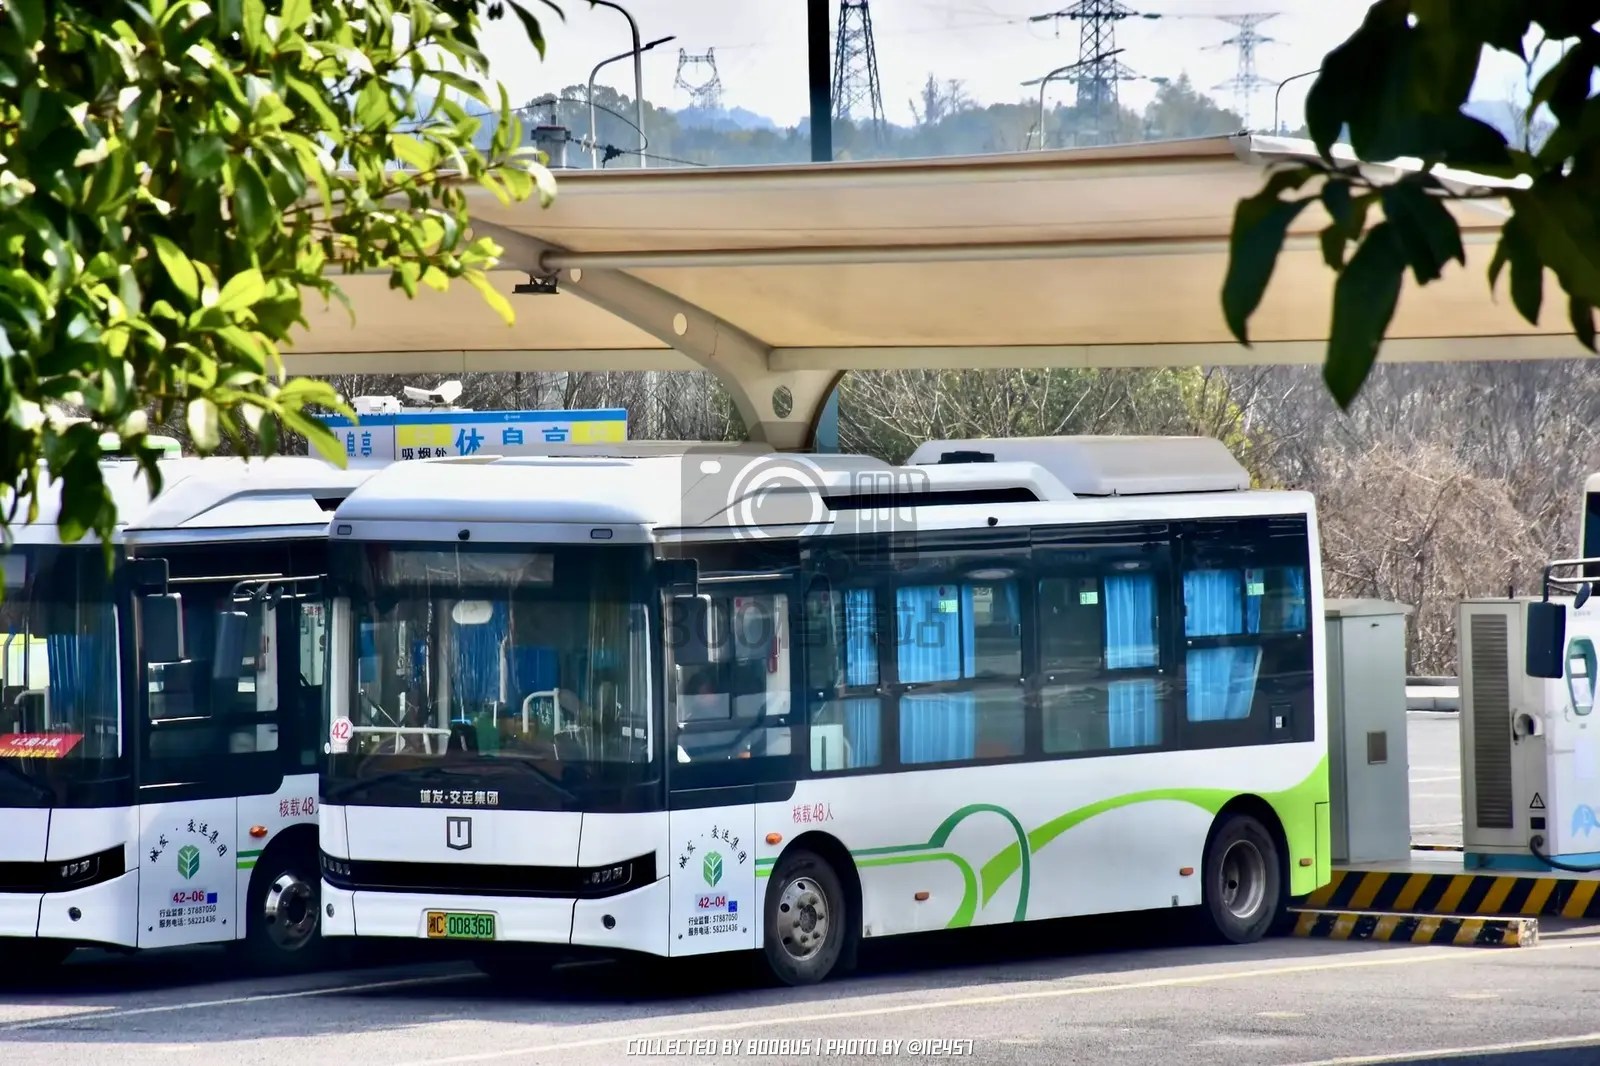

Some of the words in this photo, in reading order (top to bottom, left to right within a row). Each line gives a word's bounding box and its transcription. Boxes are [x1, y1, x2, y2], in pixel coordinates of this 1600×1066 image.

[332, 722, 349, 739] 42
[279, 796, 319, 817] 核载48
[792, 802, 834, 824] 核载48人
[173, 890, 205, 904] 42-06
[698, 896, 726, 909] 42-04
